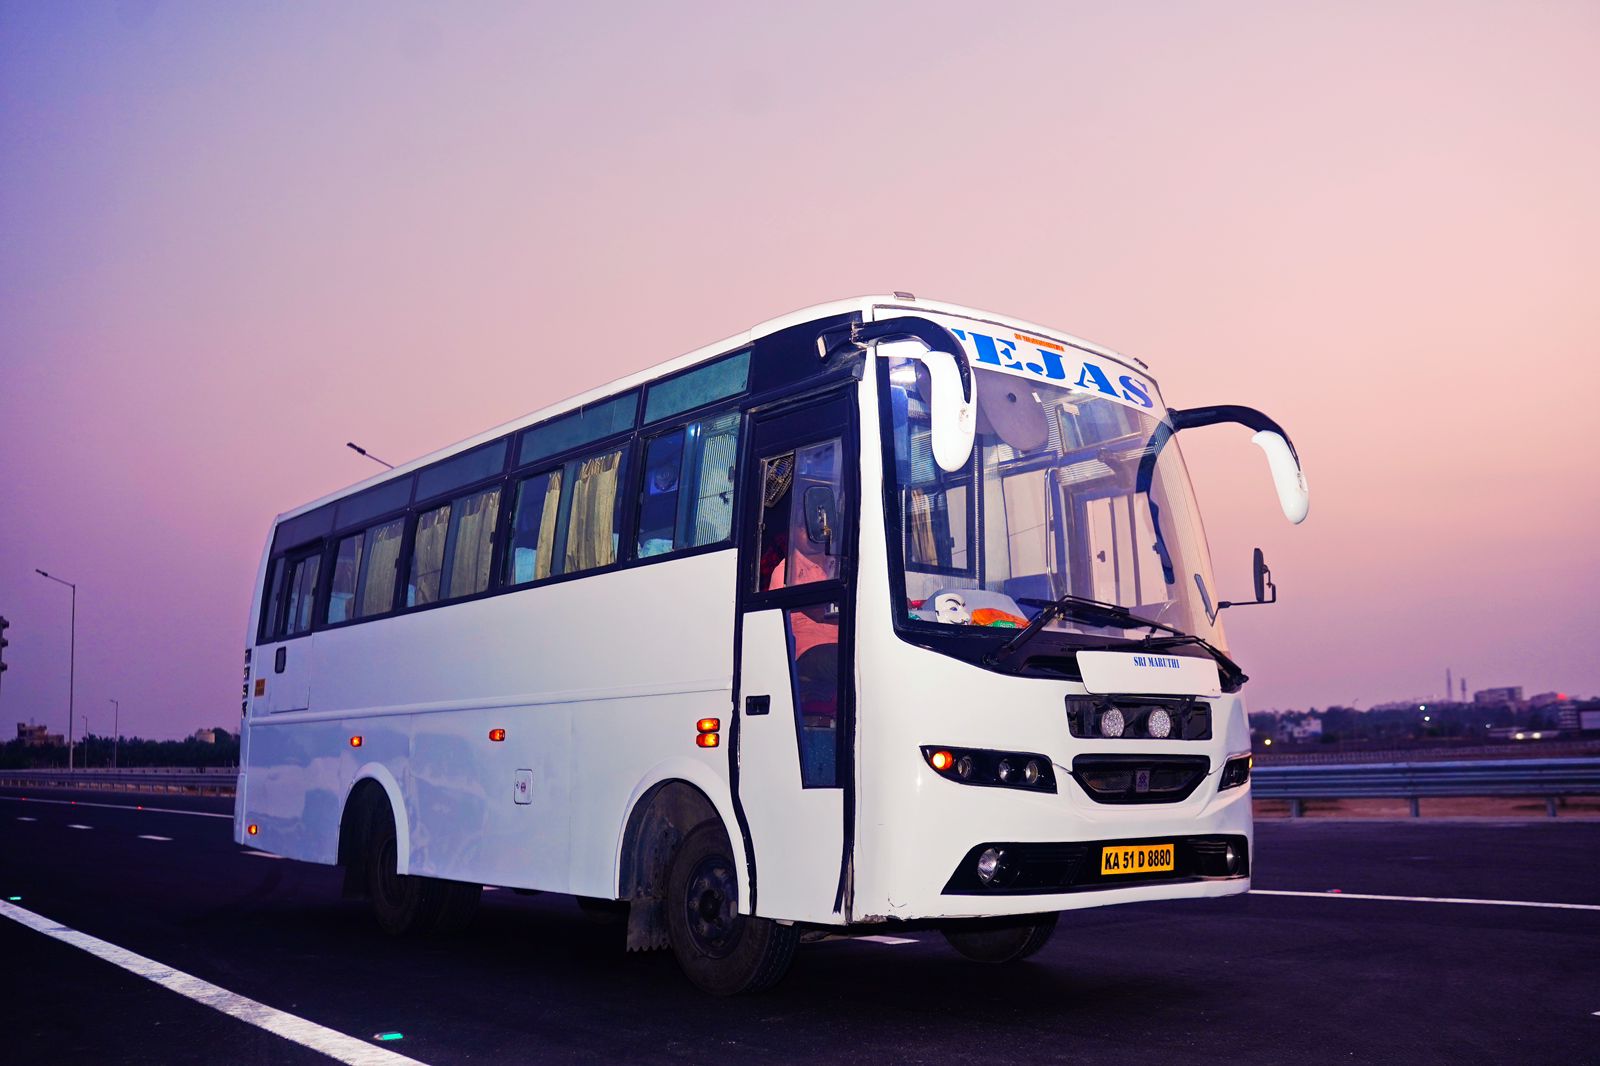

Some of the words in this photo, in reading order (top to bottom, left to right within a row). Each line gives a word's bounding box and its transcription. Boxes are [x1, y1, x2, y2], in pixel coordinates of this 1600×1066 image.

[951, 328, 1153, 408] EJAS
[1133, 656, 1146, 666] SRI
[1148, 657, 1180, 668] MARUTHI
[1104, 852, 1120, 870] KA
[1123, 851, 1134, 869] 51
[1138, 850, 1145, 868] D
[1148, 849, 1171, 867] 8880
